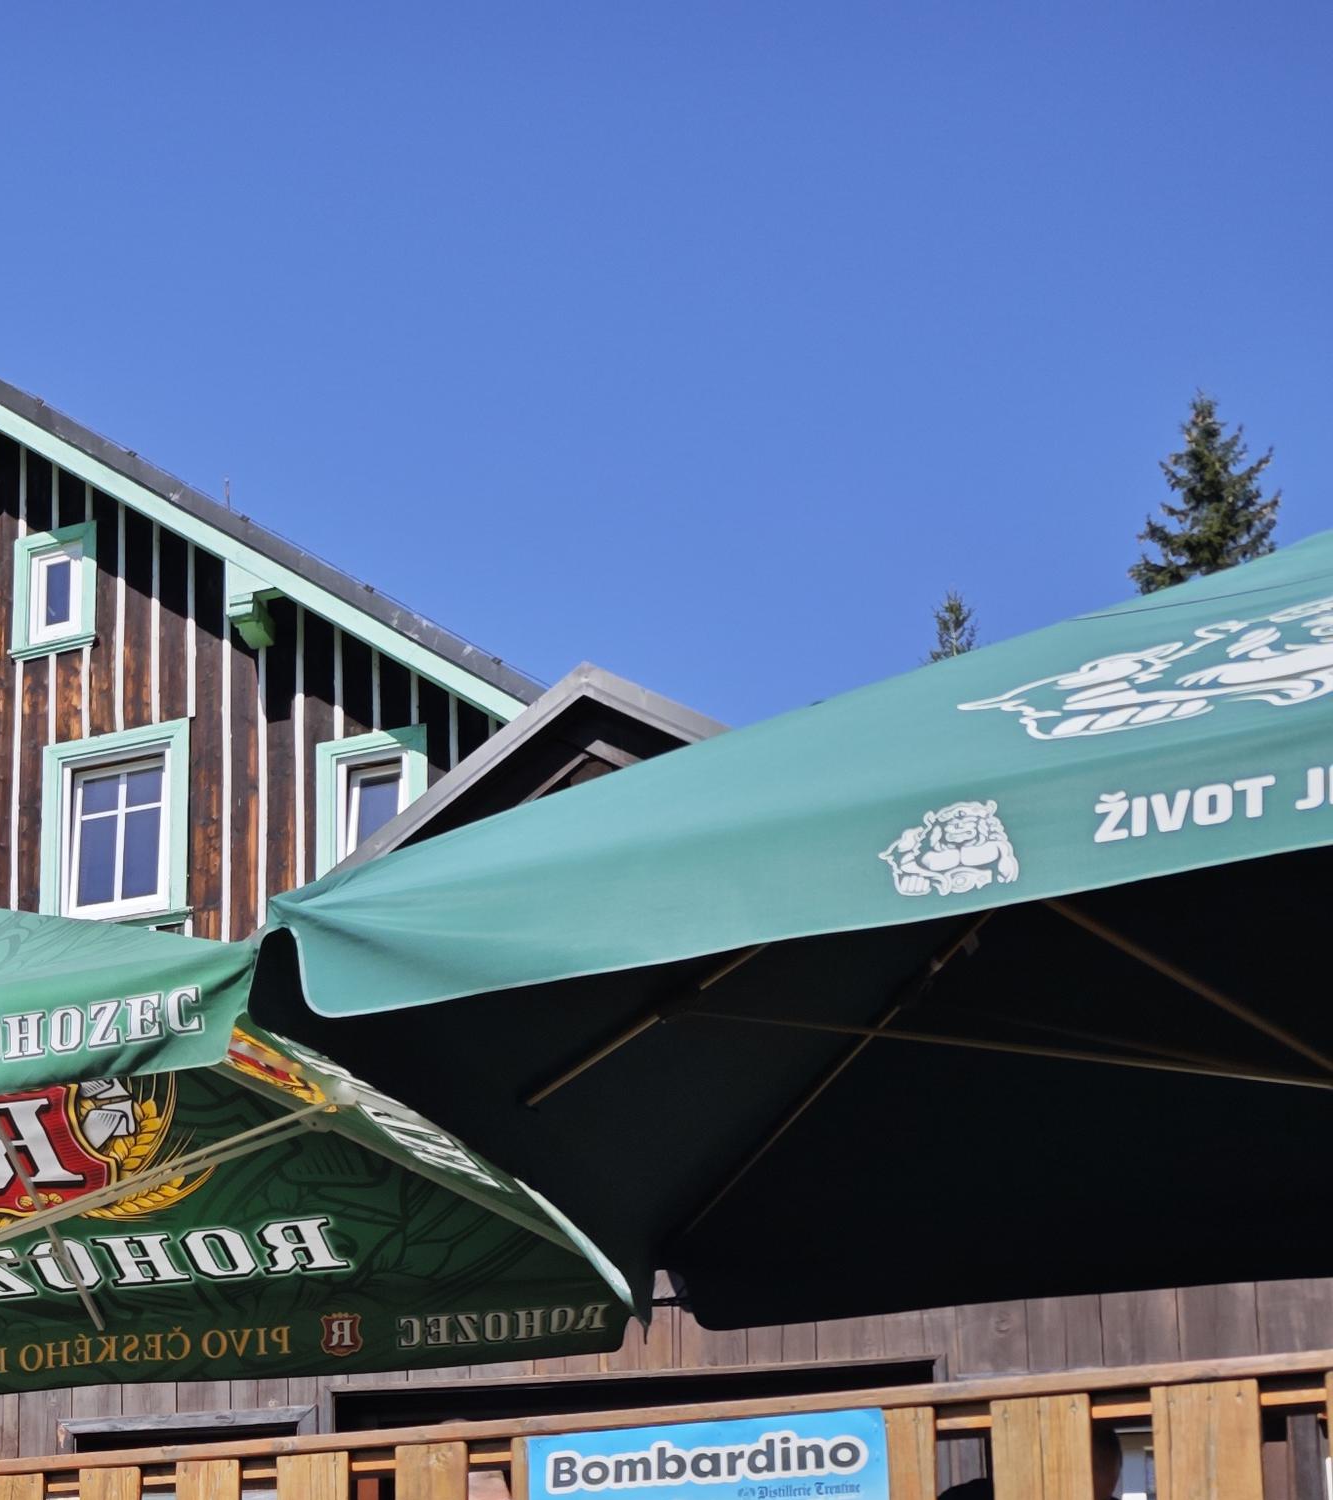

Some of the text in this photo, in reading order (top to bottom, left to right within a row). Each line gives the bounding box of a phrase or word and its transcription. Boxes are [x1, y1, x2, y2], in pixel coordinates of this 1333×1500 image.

[1094, 764, 1333, 843] ŽIVOT J
[552, 1436, 861, 1488] Bombardino
